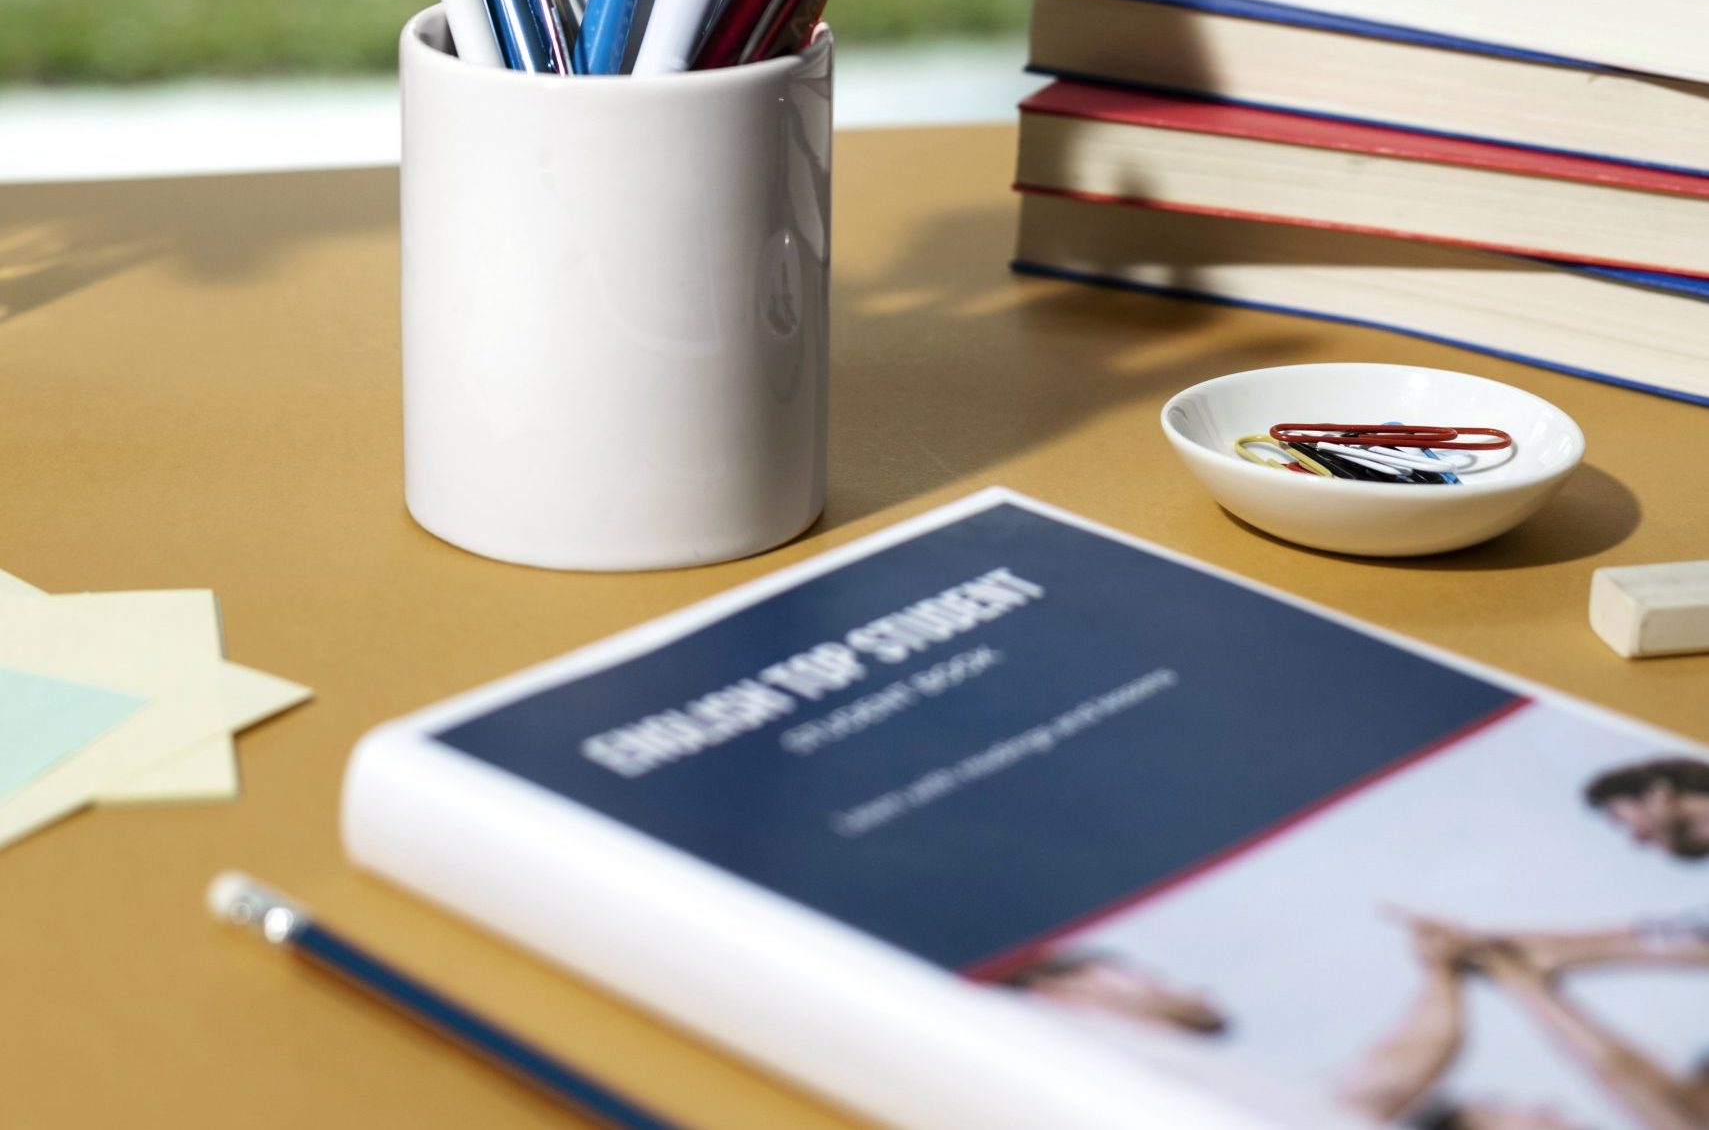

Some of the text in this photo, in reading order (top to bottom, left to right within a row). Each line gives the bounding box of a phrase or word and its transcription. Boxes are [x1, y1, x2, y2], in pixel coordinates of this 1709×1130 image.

[583, 567, 1045, 778] ENGLISH TOP STUDENT
